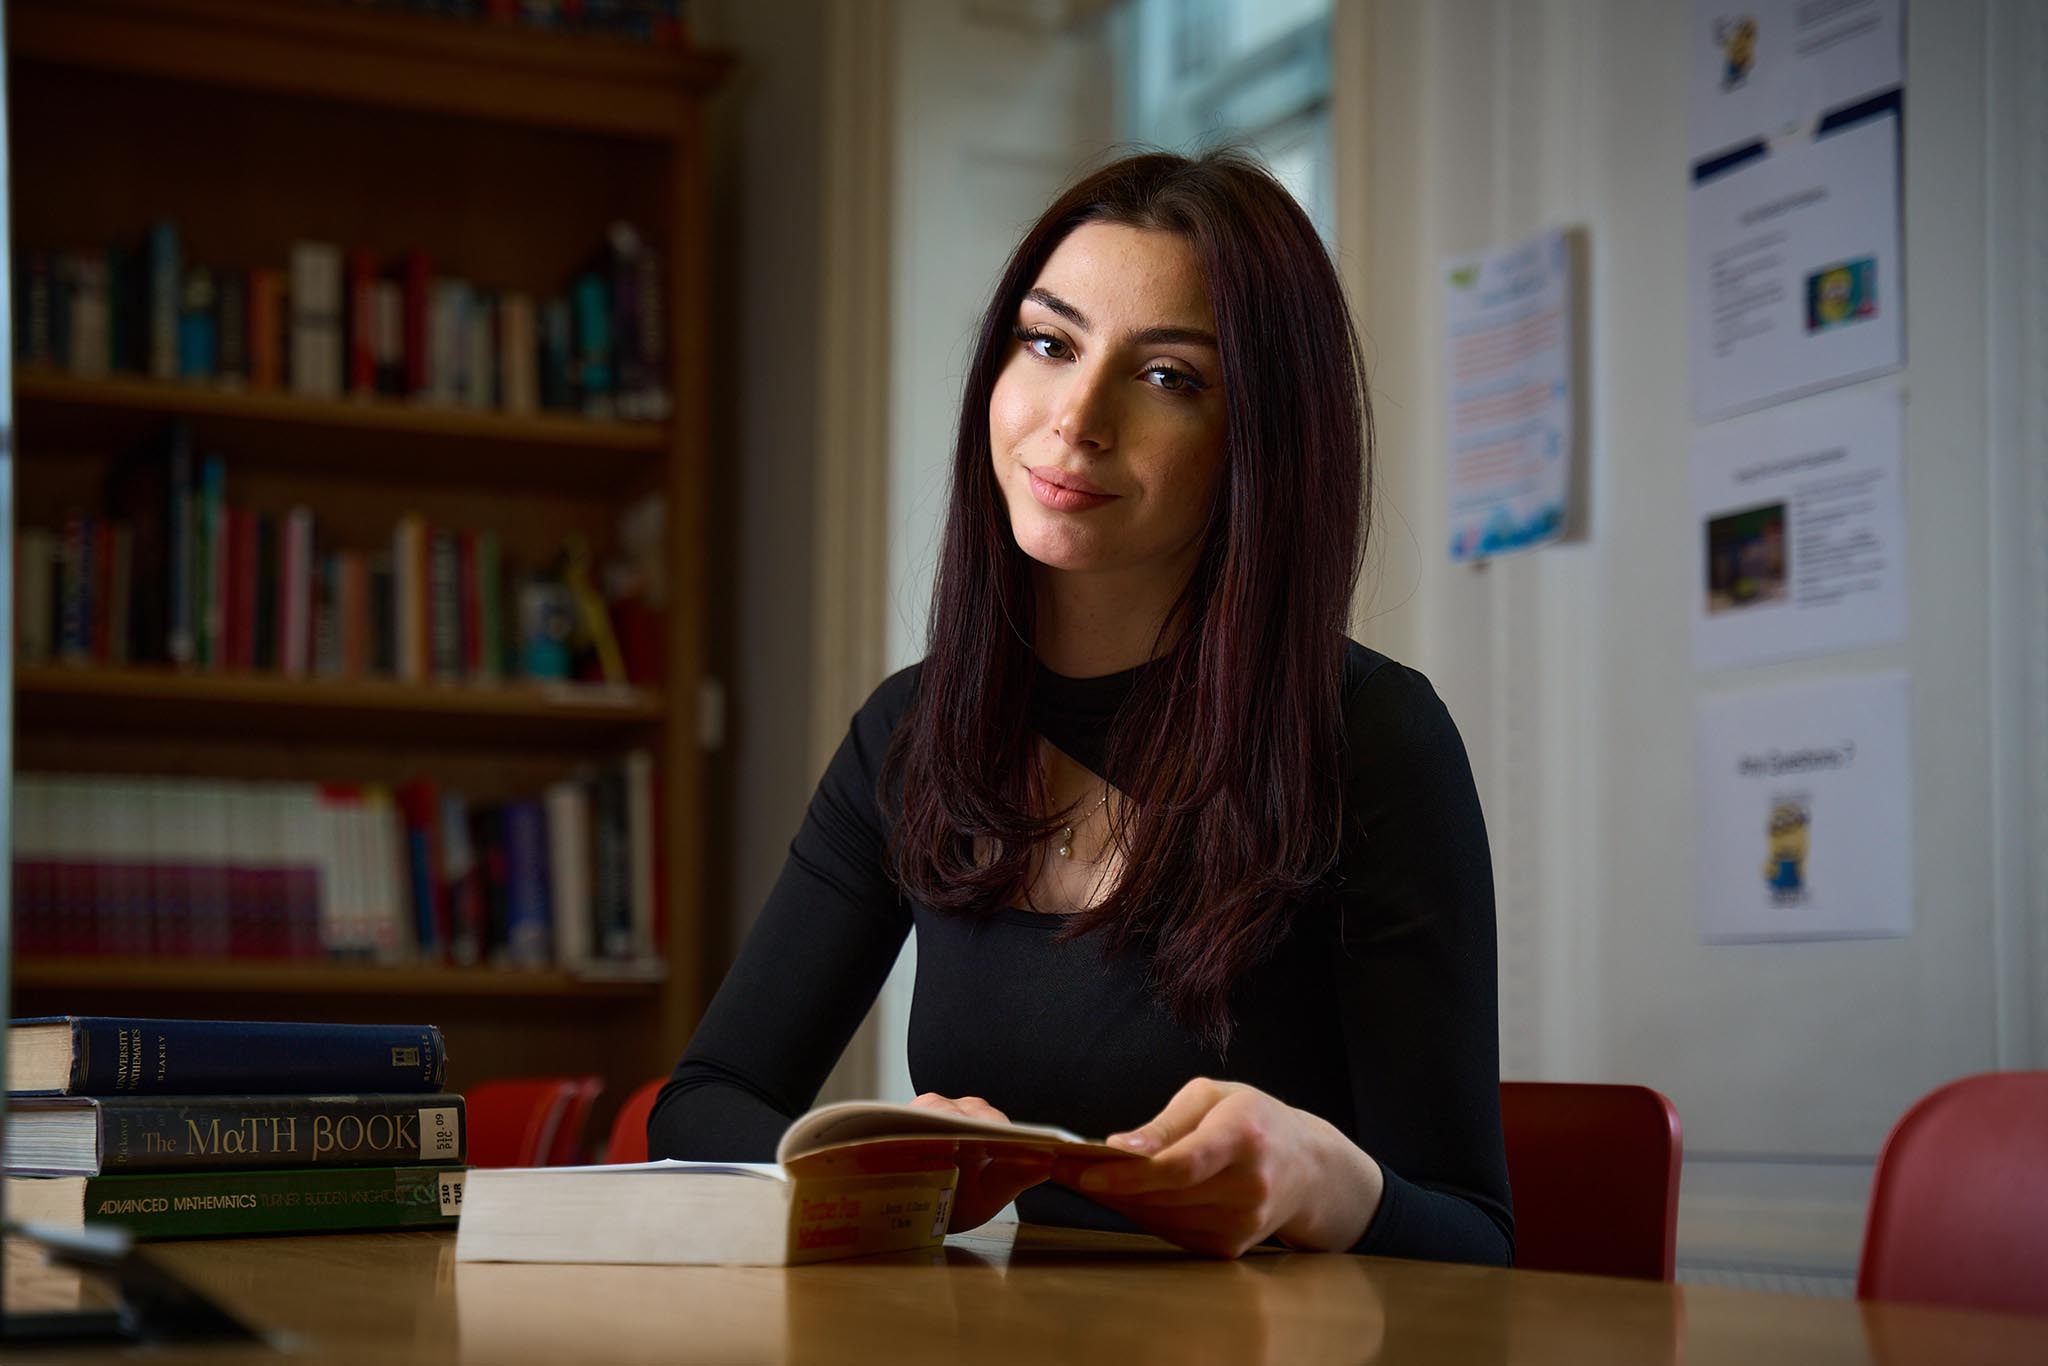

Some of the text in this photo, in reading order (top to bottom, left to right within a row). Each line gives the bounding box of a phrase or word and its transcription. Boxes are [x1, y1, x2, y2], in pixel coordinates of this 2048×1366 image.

[115, 1028, 128, 1089] UNIVERSITY
[127, 1028, 142, 1090] MATHEMATICS
[142, 1131, 177, 1153] The
[435, 1113, 445, 1150] 510.09
[445, 1130, 453, 1150] PIC
[97, 1198, 168, 1215] ADVANCED
[174, 1194, 257, 1211] MATHEMATICS
[441, 1184, 451, 1204] 510
[453, 1183, 462, 1205] TUR
